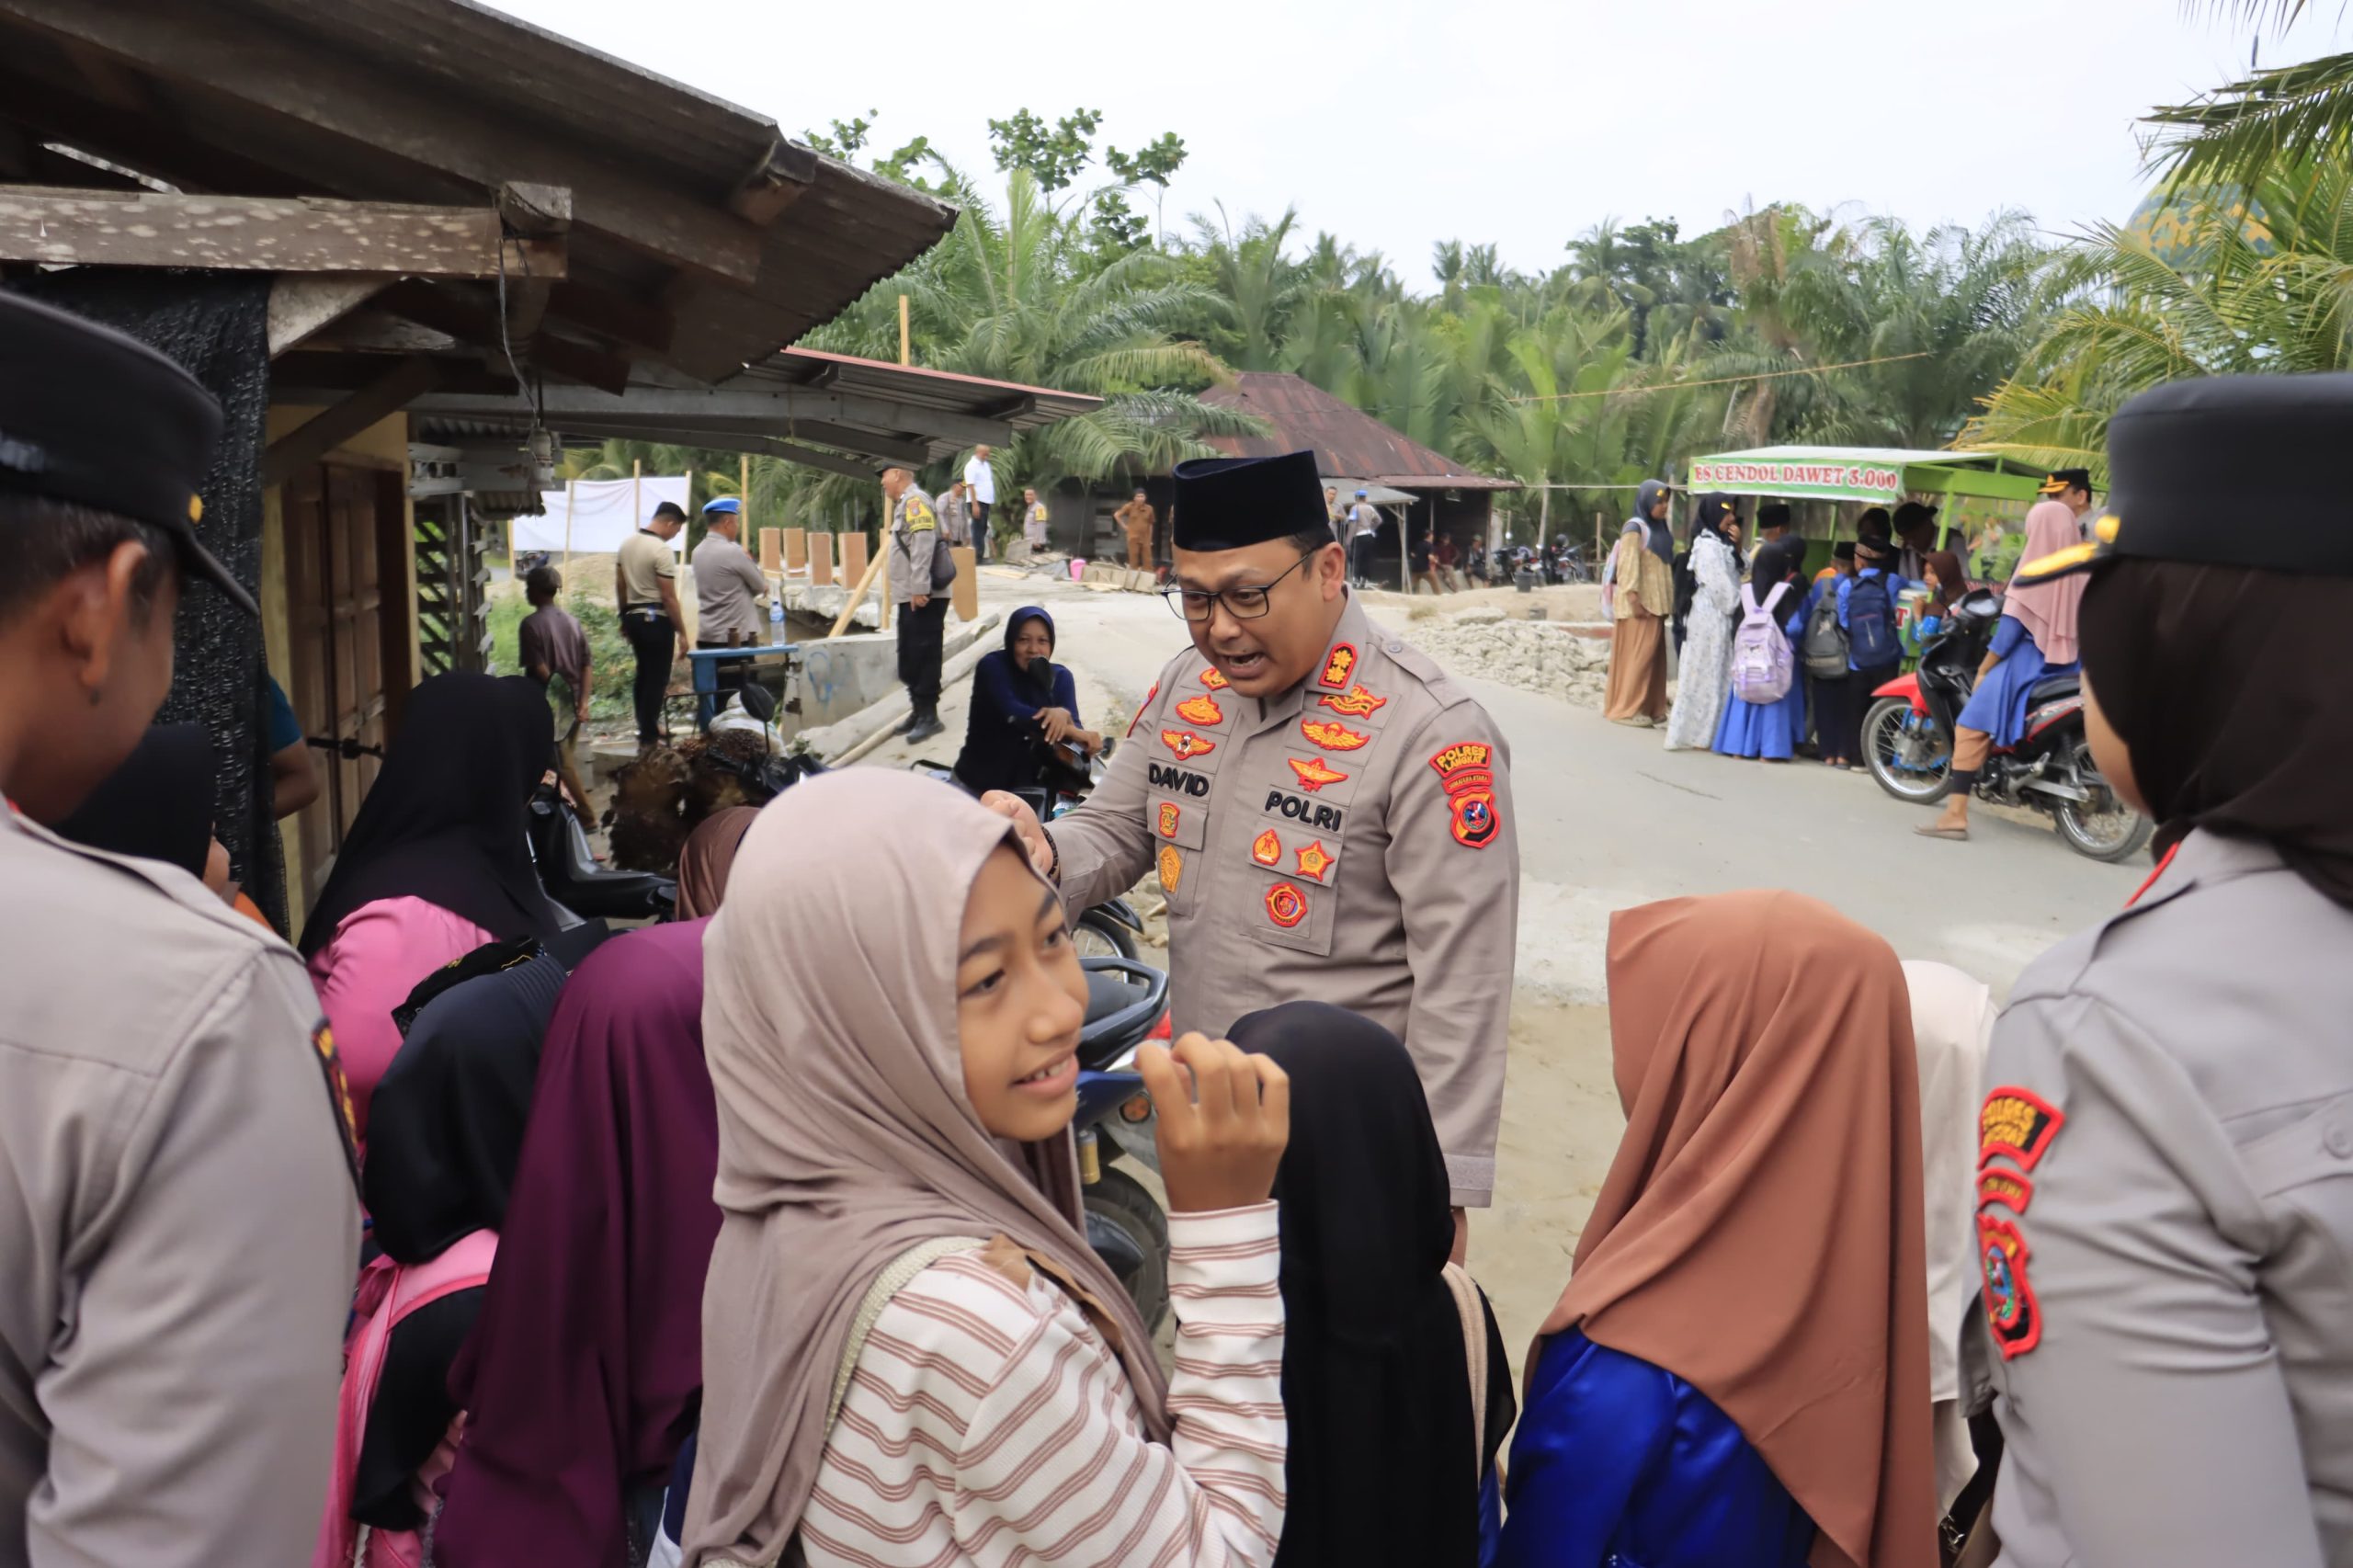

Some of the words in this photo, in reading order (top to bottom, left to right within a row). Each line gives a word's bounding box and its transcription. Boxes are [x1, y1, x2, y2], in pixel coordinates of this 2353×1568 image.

[1693, 465, 1711, 483] ES
[1714, 464, 1779, 483] CENDOL
[1782, 465, 1845, 485] DAWET
[1436, 745, 1486, 768] POLRES
[1149, 762, 1210, 797] DAVID
[1264, 790, 1342, 832] POLRI
